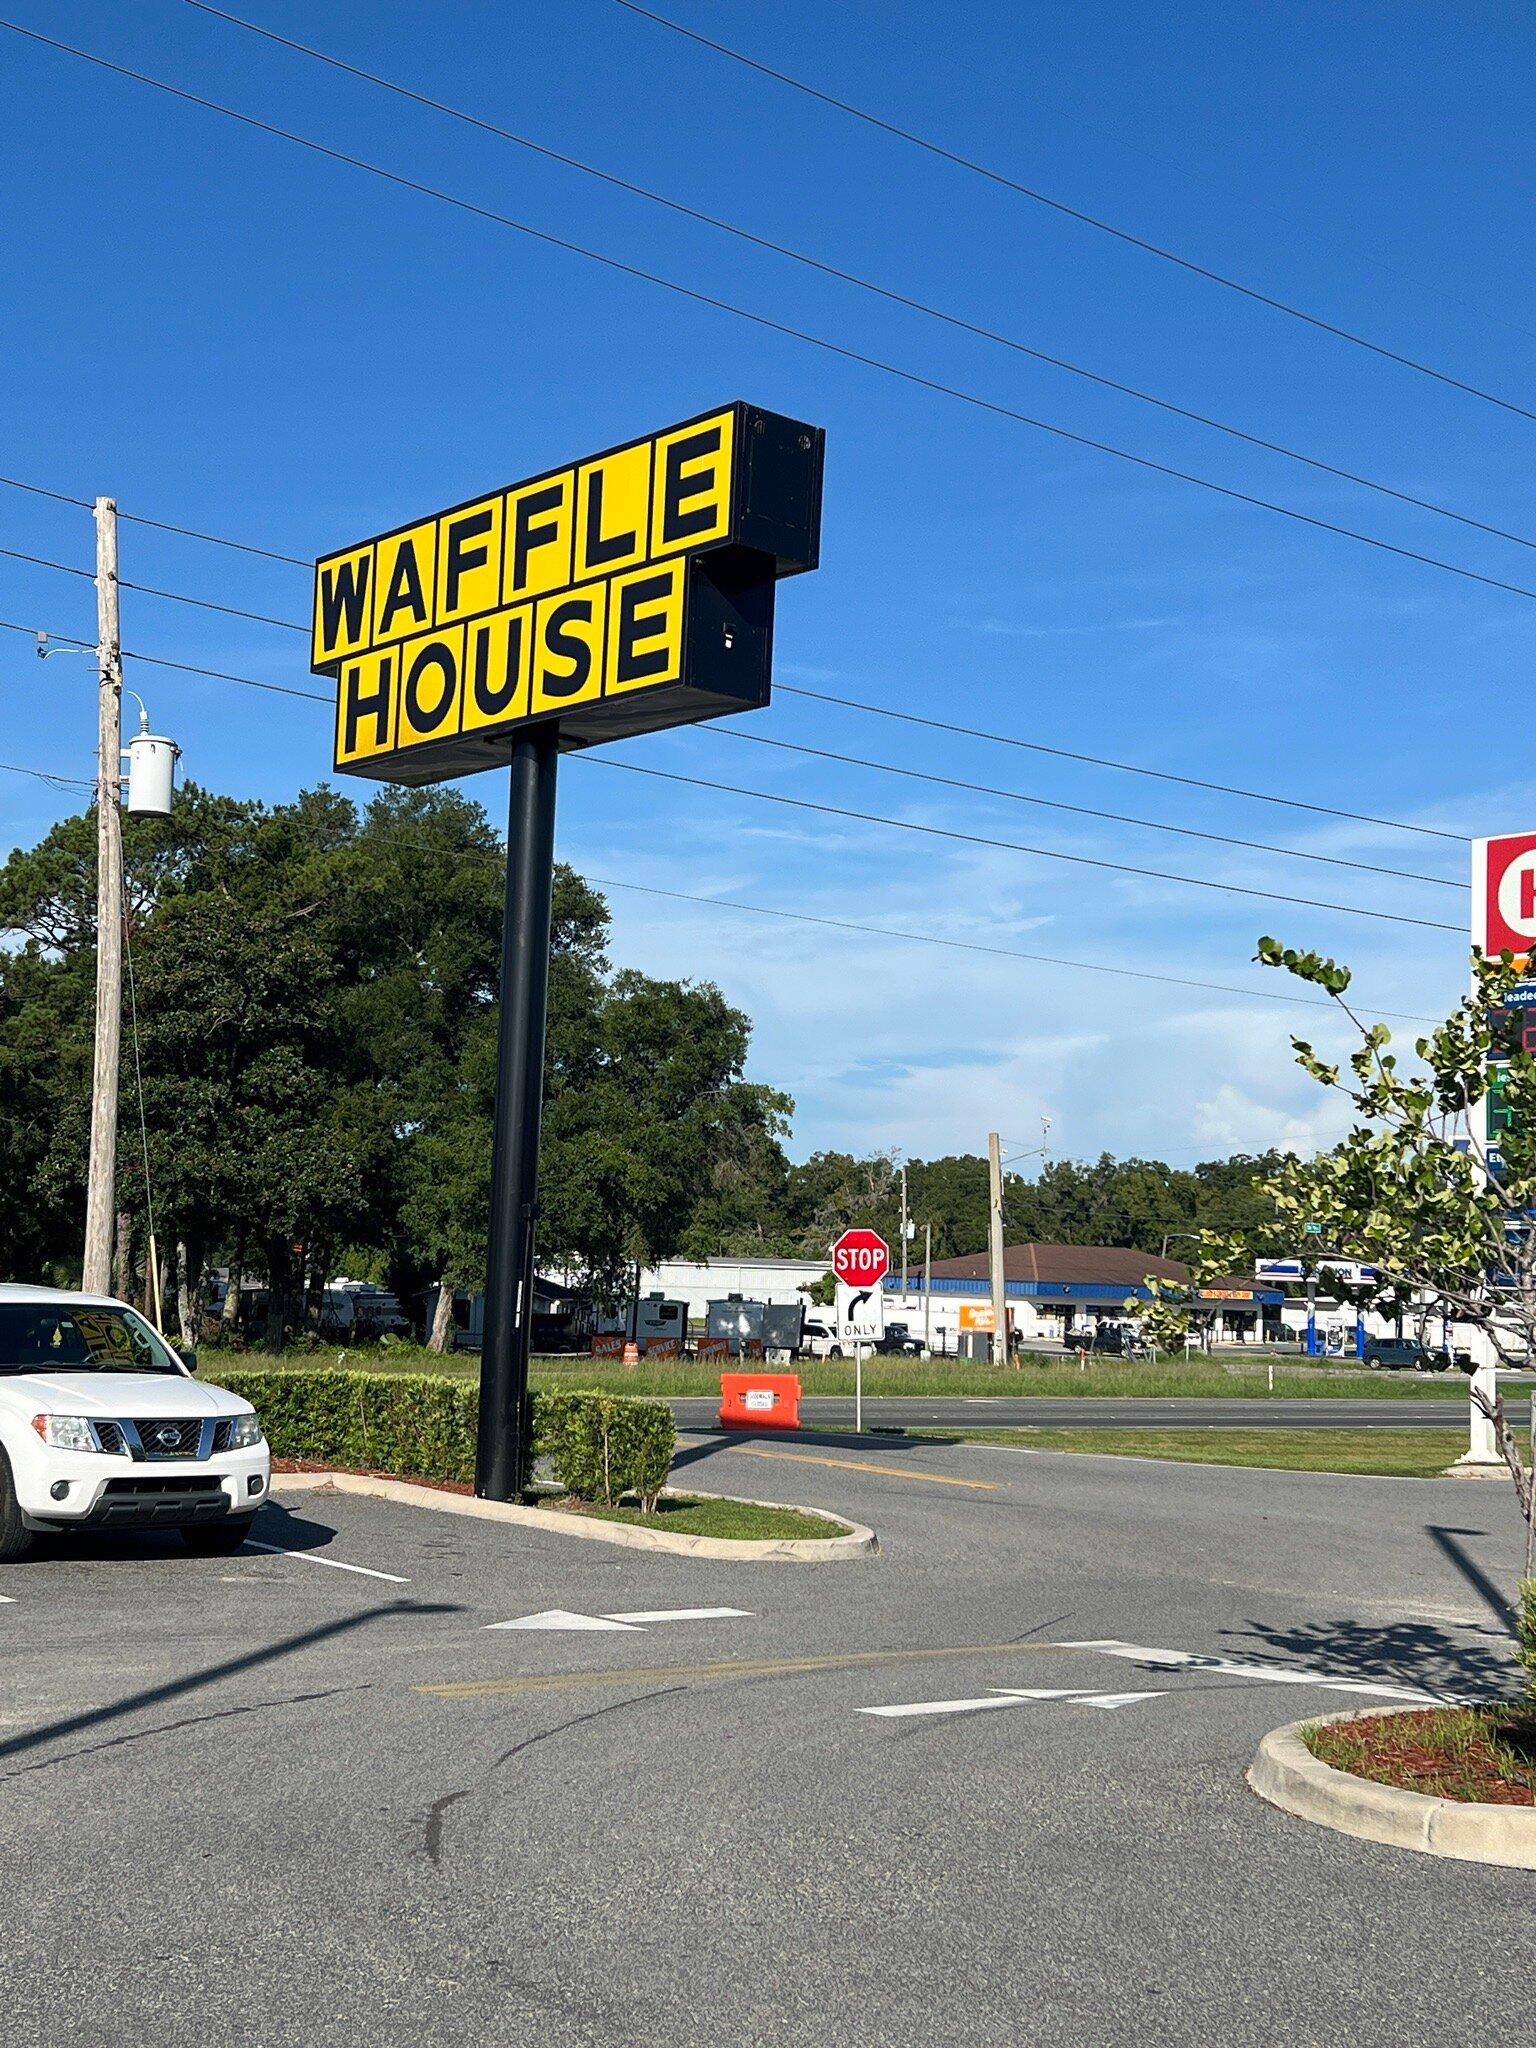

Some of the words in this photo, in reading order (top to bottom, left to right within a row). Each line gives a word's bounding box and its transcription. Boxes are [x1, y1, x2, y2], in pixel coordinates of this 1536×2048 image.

[321, 426, 722, 652] WAFFLE
[344, 571, 673, 754] HOUSE
[1504, 990, 1536, 1003] leade
[836, 1247, 885, 1271] STOP
[844, 1324, 876, 1336] ONLY
